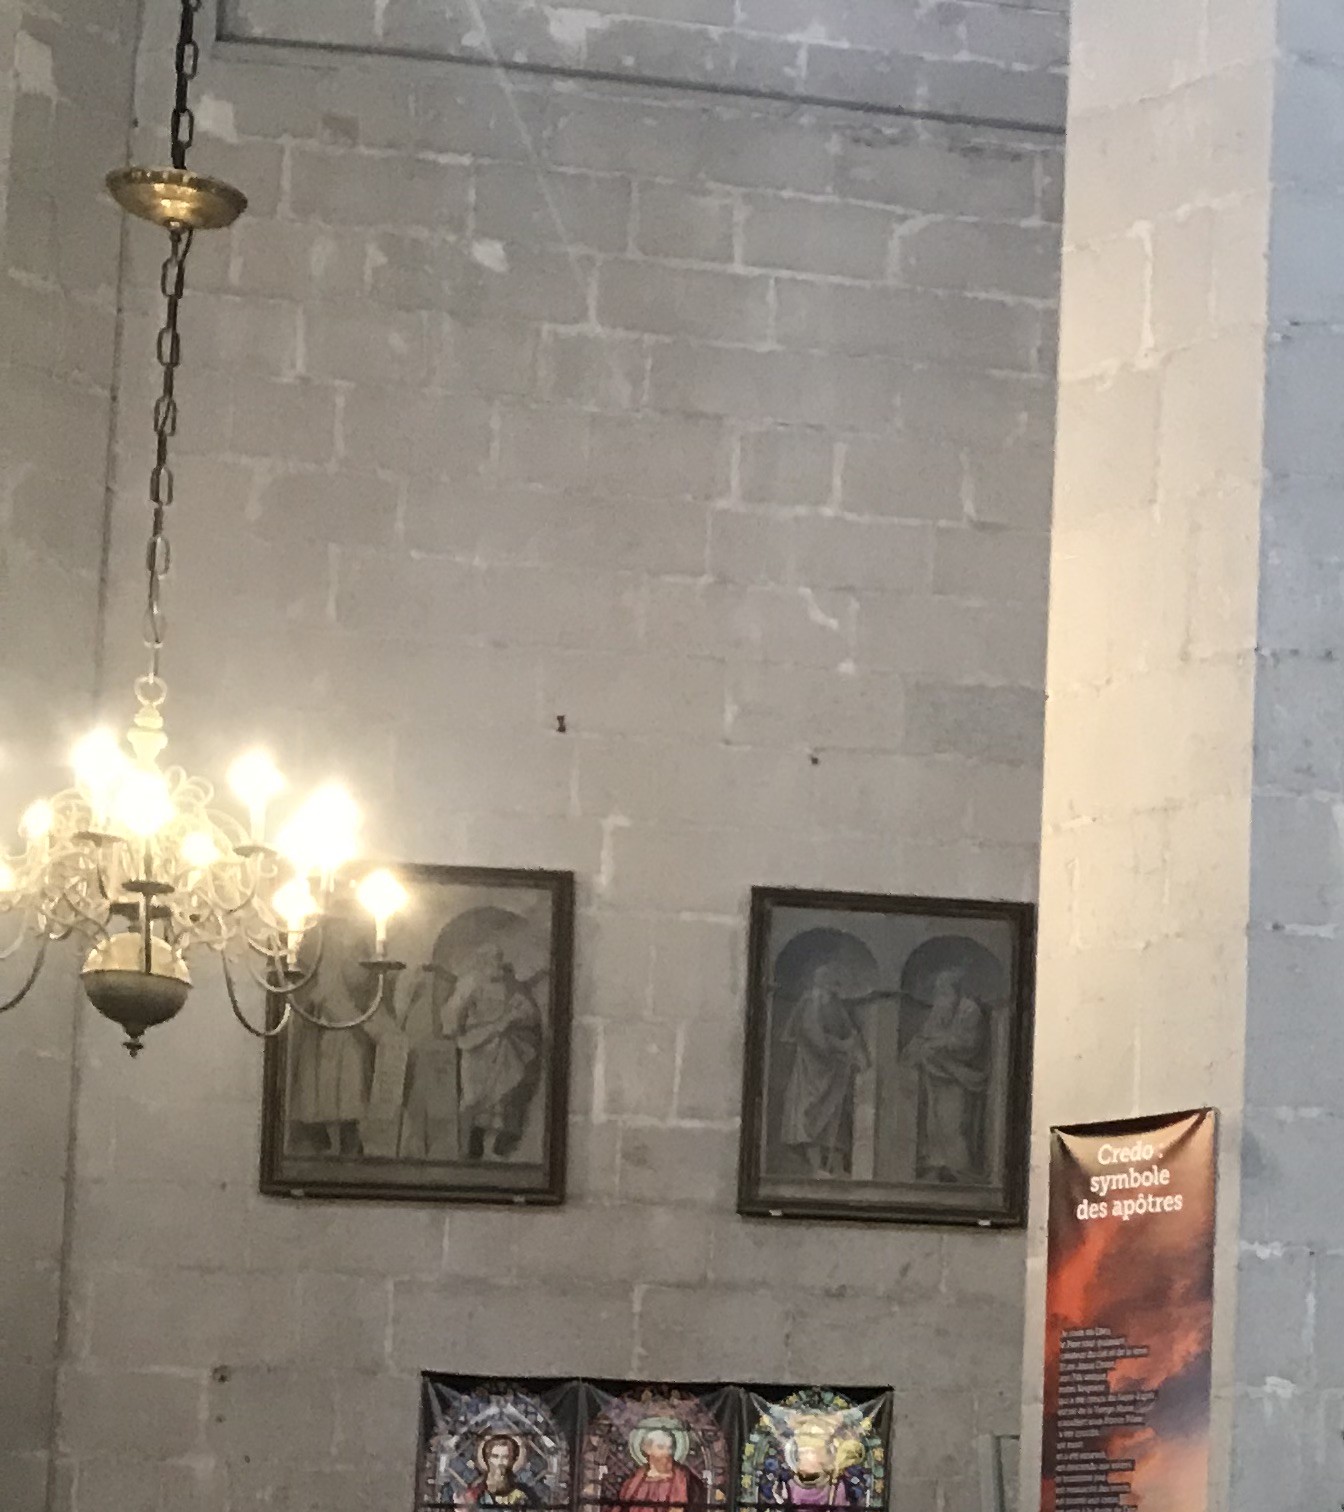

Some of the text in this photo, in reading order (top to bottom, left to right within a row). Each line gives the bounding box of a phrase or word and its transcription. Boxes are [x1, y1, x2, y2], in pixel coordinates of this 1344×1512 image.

[1098, 1142, 1154, 1165] Credo
[1090, 1165, 1170, 1196] symbole
[1076, 1193, 1183, 1221] des apôtres
